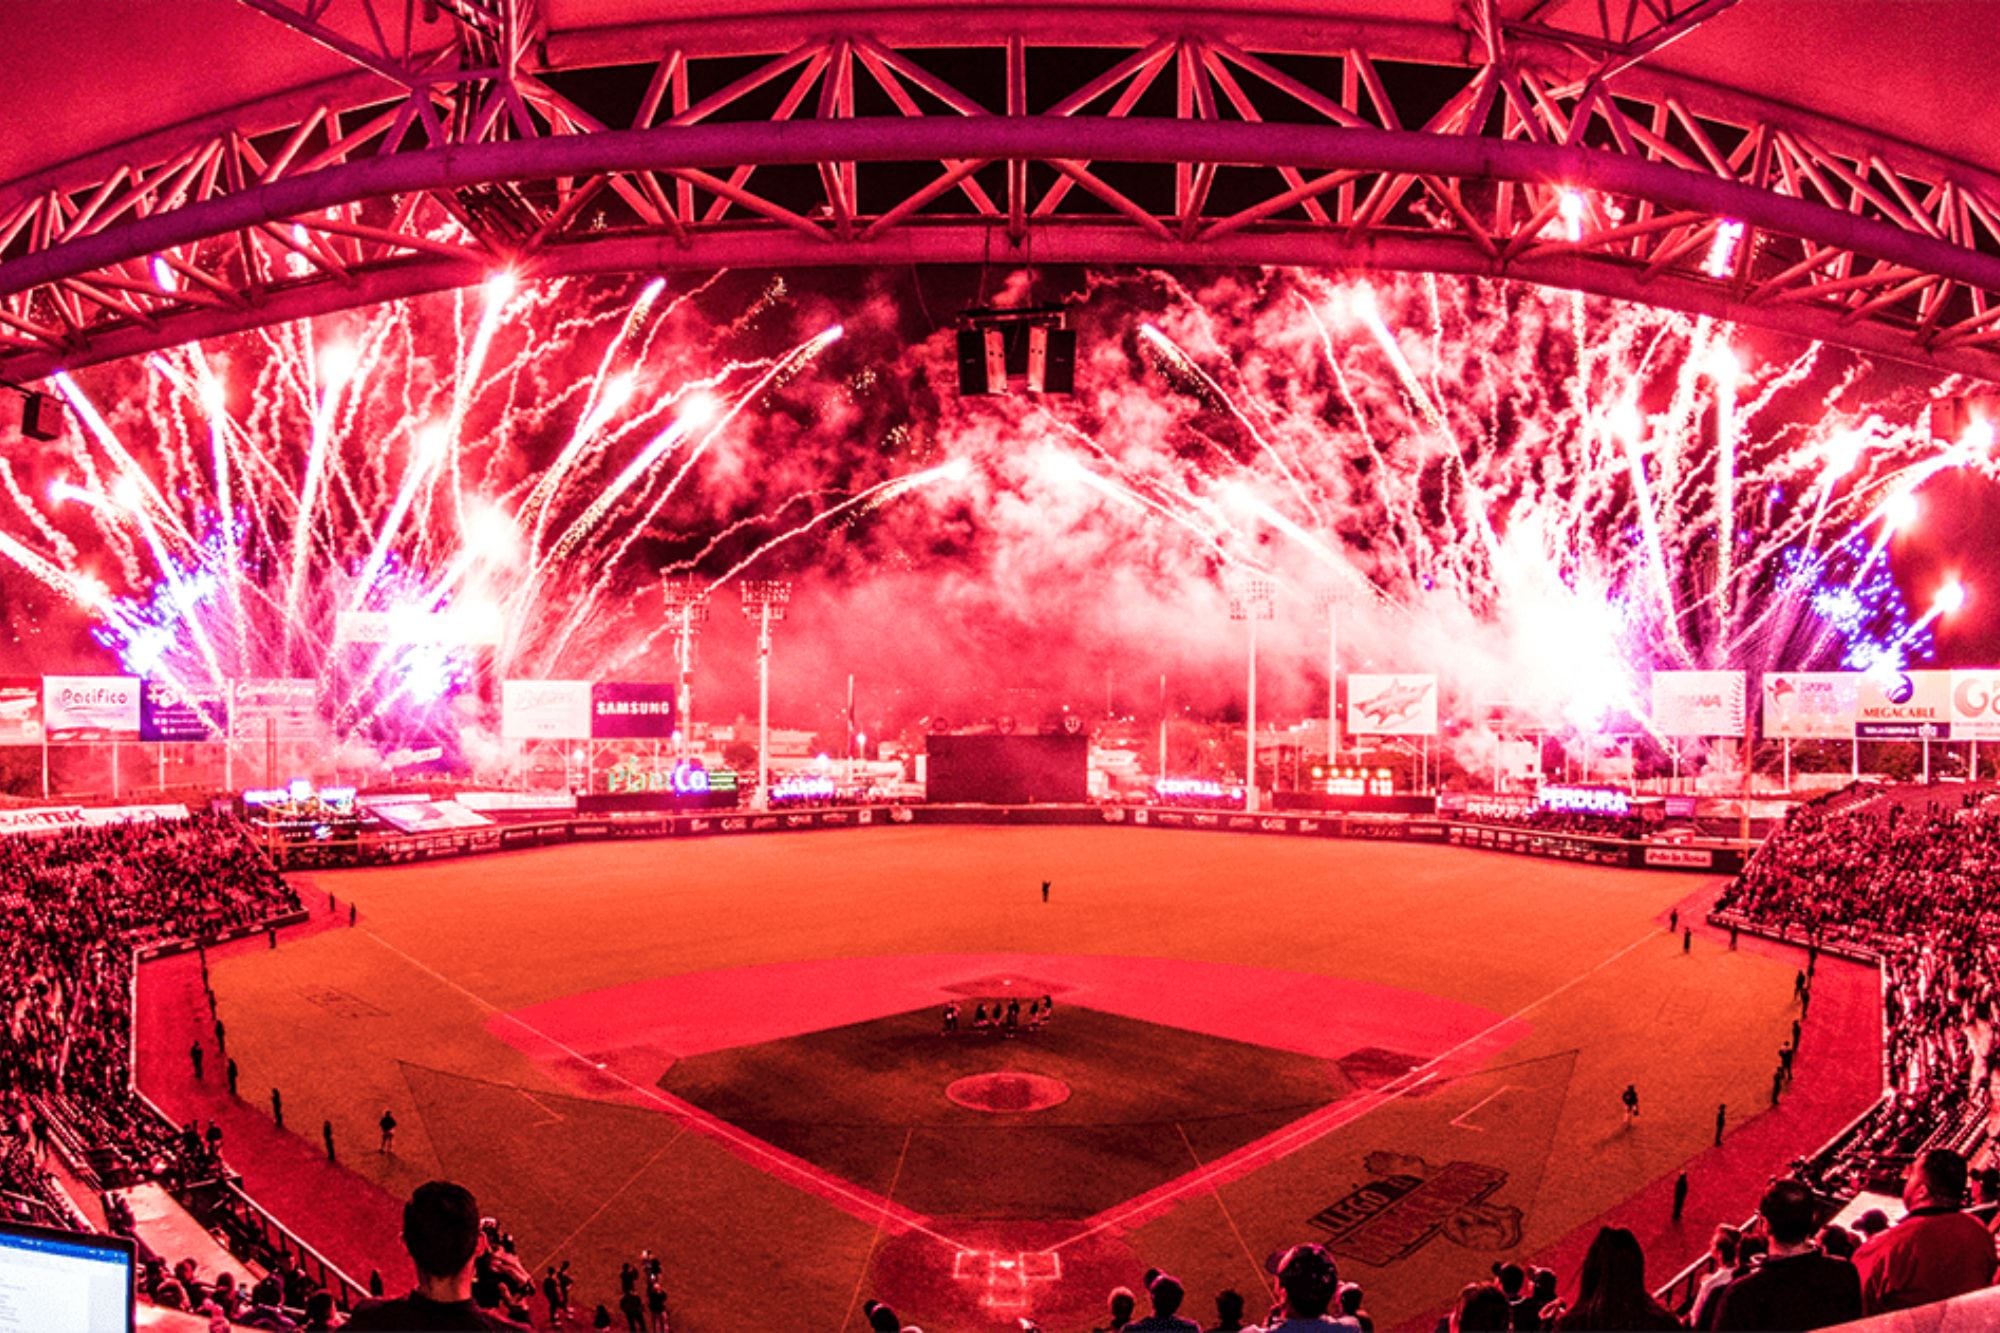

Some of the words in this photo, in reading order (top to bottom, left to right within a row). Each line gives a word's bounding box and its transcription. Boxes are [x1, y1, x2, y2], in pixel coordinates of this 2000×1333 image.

[61, 687, 128, 705] Pacifico
[596, 701, 669, 715] SAMSUNG
[1863, 707, 1935, 718] MEGACABLE
[1539, 787, 1629, 812] PERDURA
